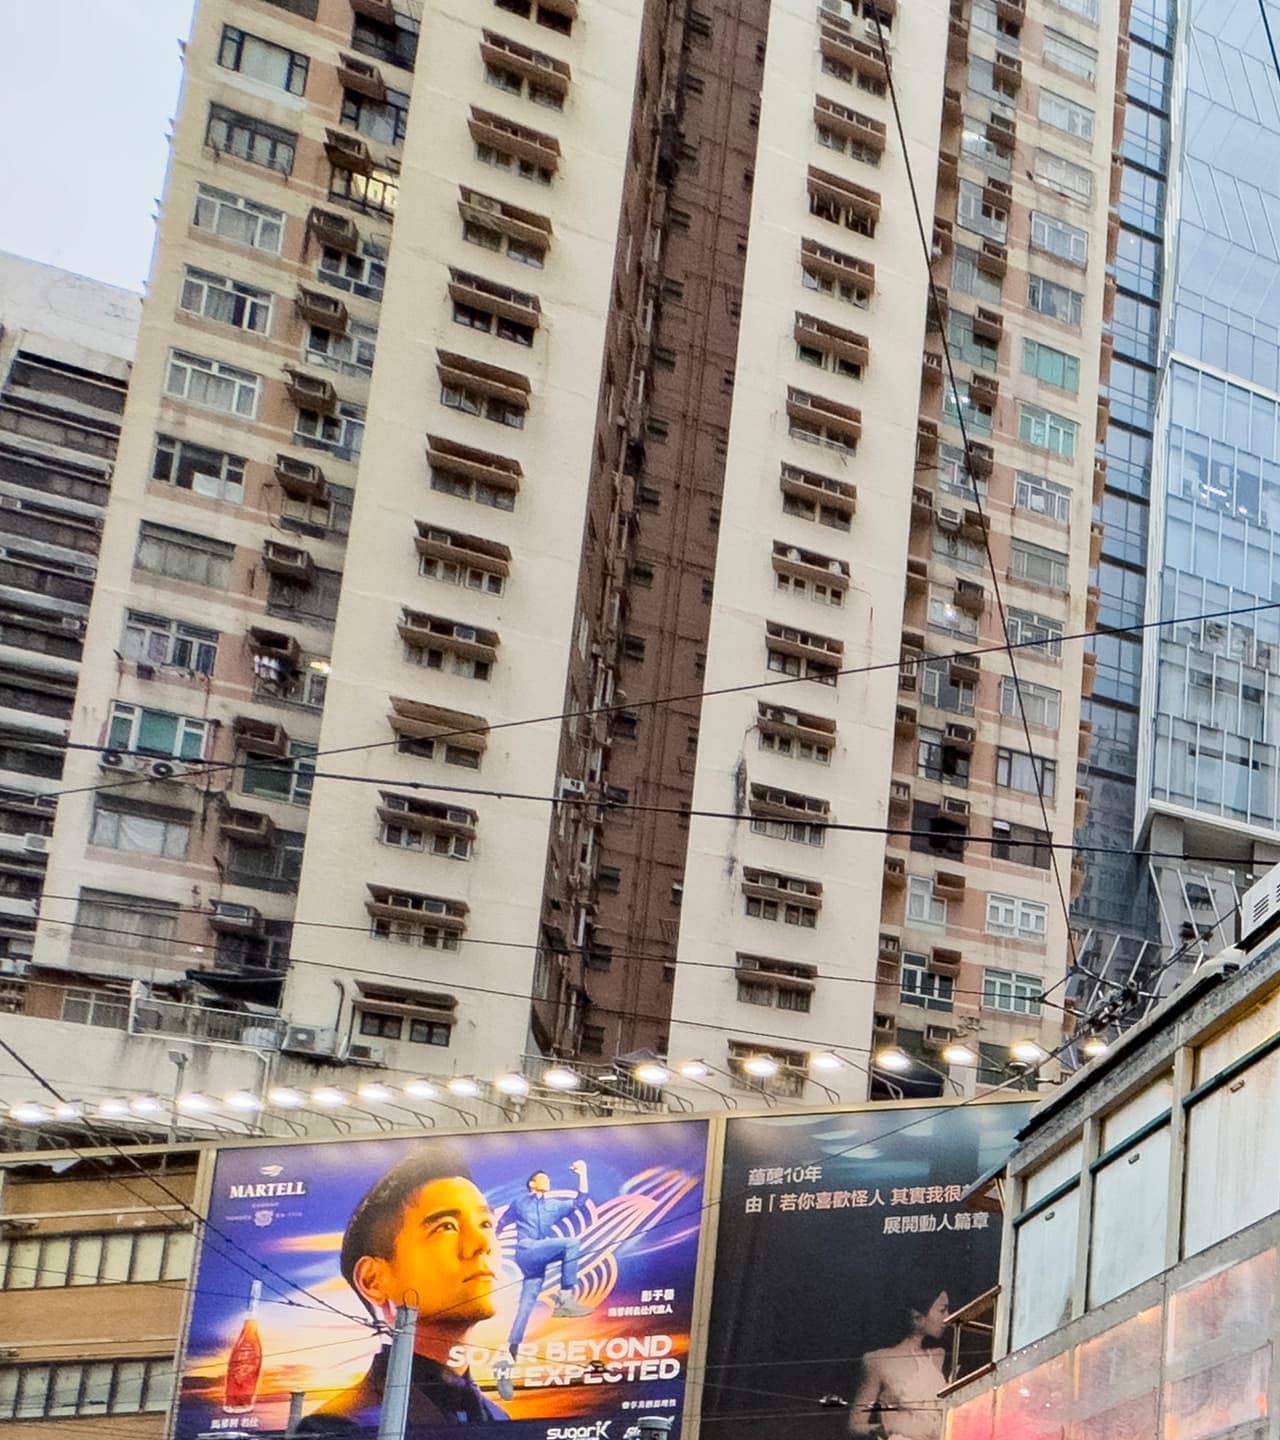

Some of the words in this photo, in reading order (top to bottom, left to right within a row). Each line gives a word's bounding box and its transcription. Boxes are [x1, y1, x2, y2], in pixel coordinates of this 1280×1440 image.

[229, 1181, 307, 1199] MARTELL
[890, 1184, 970, 1206] 其實我很
[882, 1211, 990, 1235] 展開動人篇章
[446, 1341, 539, 1368] SOAR
[545, 1334, 673, 1362] BEYOND
[492, 1367, 521, 1380] THE
[524, 1358, 680, 1387] EXPECTED
